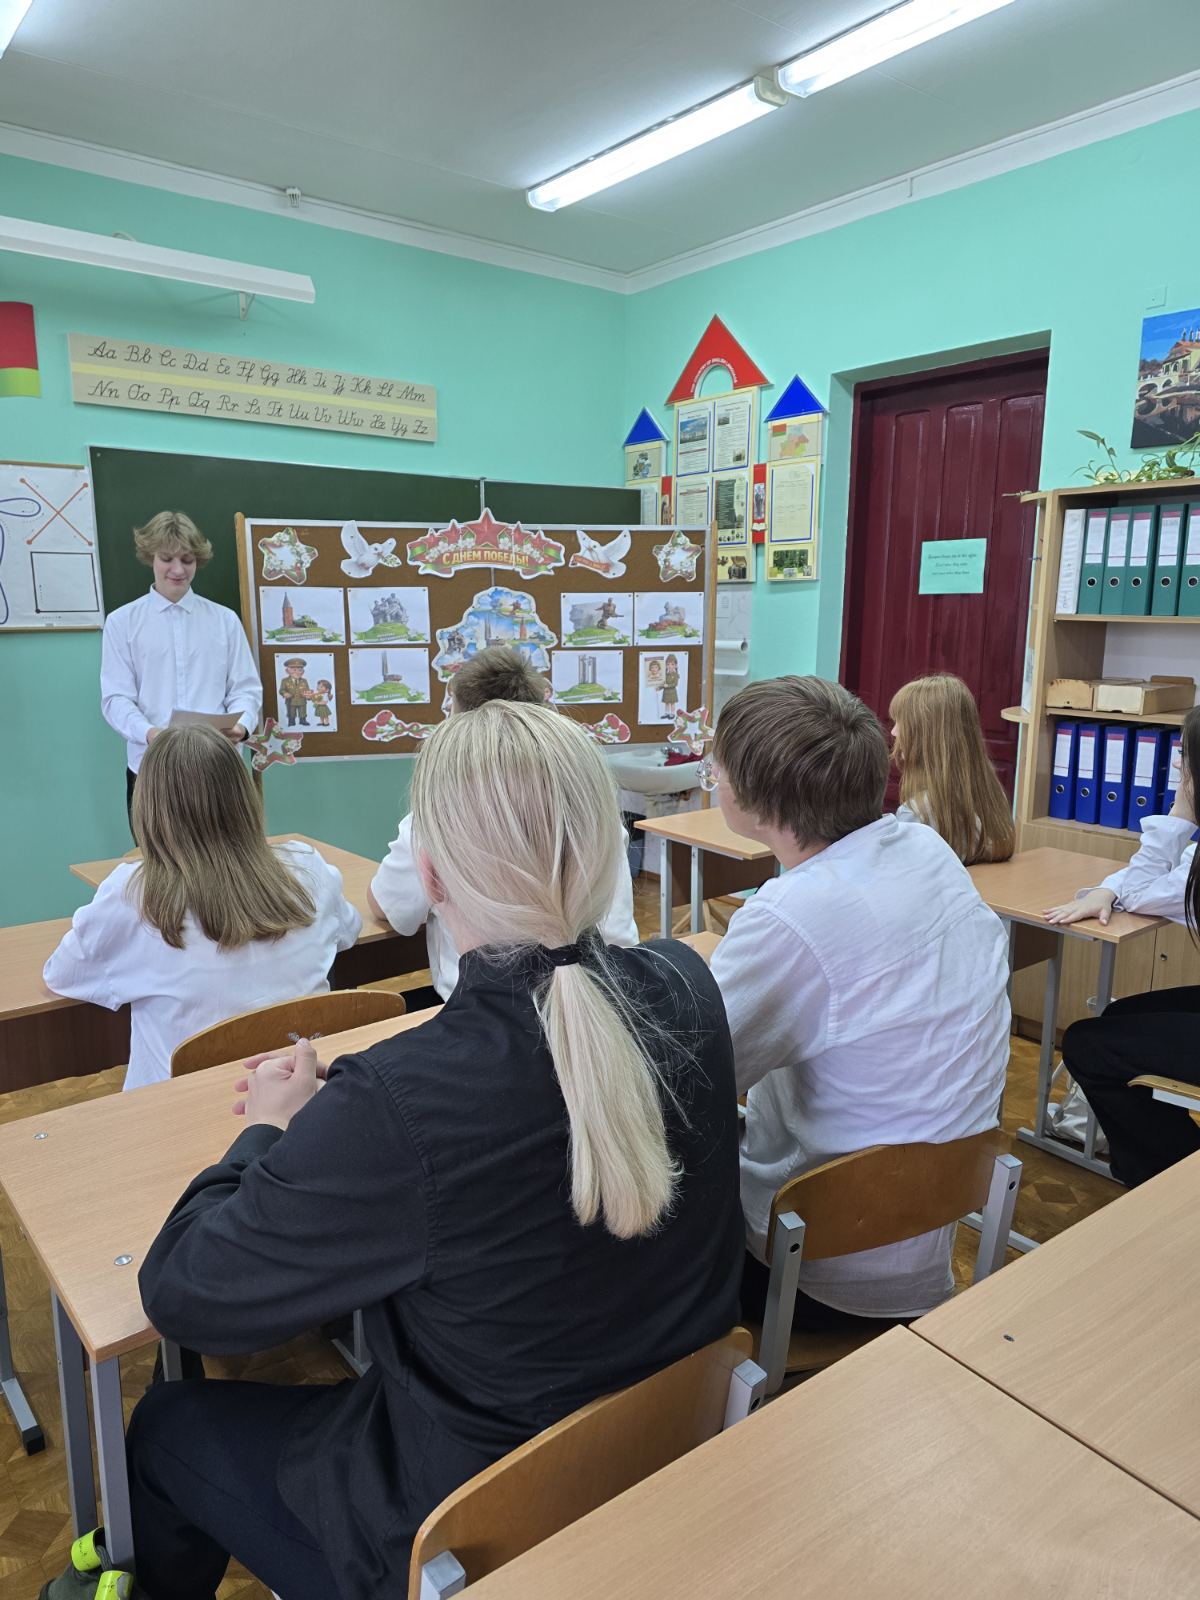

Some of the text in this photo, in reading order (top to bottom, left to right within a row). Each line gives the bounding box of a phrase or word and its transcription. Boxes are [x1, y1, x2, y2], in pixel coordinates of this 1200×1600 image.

[88, 341, 117, 360] Aa
[124, 344, 152, 364] Bb
[159, 349, 176, 368] Cc
[183, 352, 208, 372] Dd
[216, 357, 231, 375] Ee
[236, 360, 256, 383] Ff
[260, 364, 280, 387] Gg
[286, 367, 307, 386] Hh
[313, 371, 327, 388] Ii
[333, 374, 347, 396] Jj
[376, 382, 392, 398] Ll
[396, 385, 426, 403] Mm
[88, 380, 120, 399] Nn
[127, 383, 151, 402] Oo
[157, 387, 181, 410] Pp
[188, 391, 211, 414] Qq
[216, 394, 239, 413] Rr
[244, 399, 261, 415] Ss
[266, 400, 283, 418] Tt
[288, 403, 309, 421] Uu
[314, 406, 332, 423] Vv
[338, 409, 365, 427] Ww
[391, 416, 408, 437] Yy
[412, 419, 428, 435] Zz
[442, 550, 529, 567] С ДНЕМ ПОБЕДЫ!
